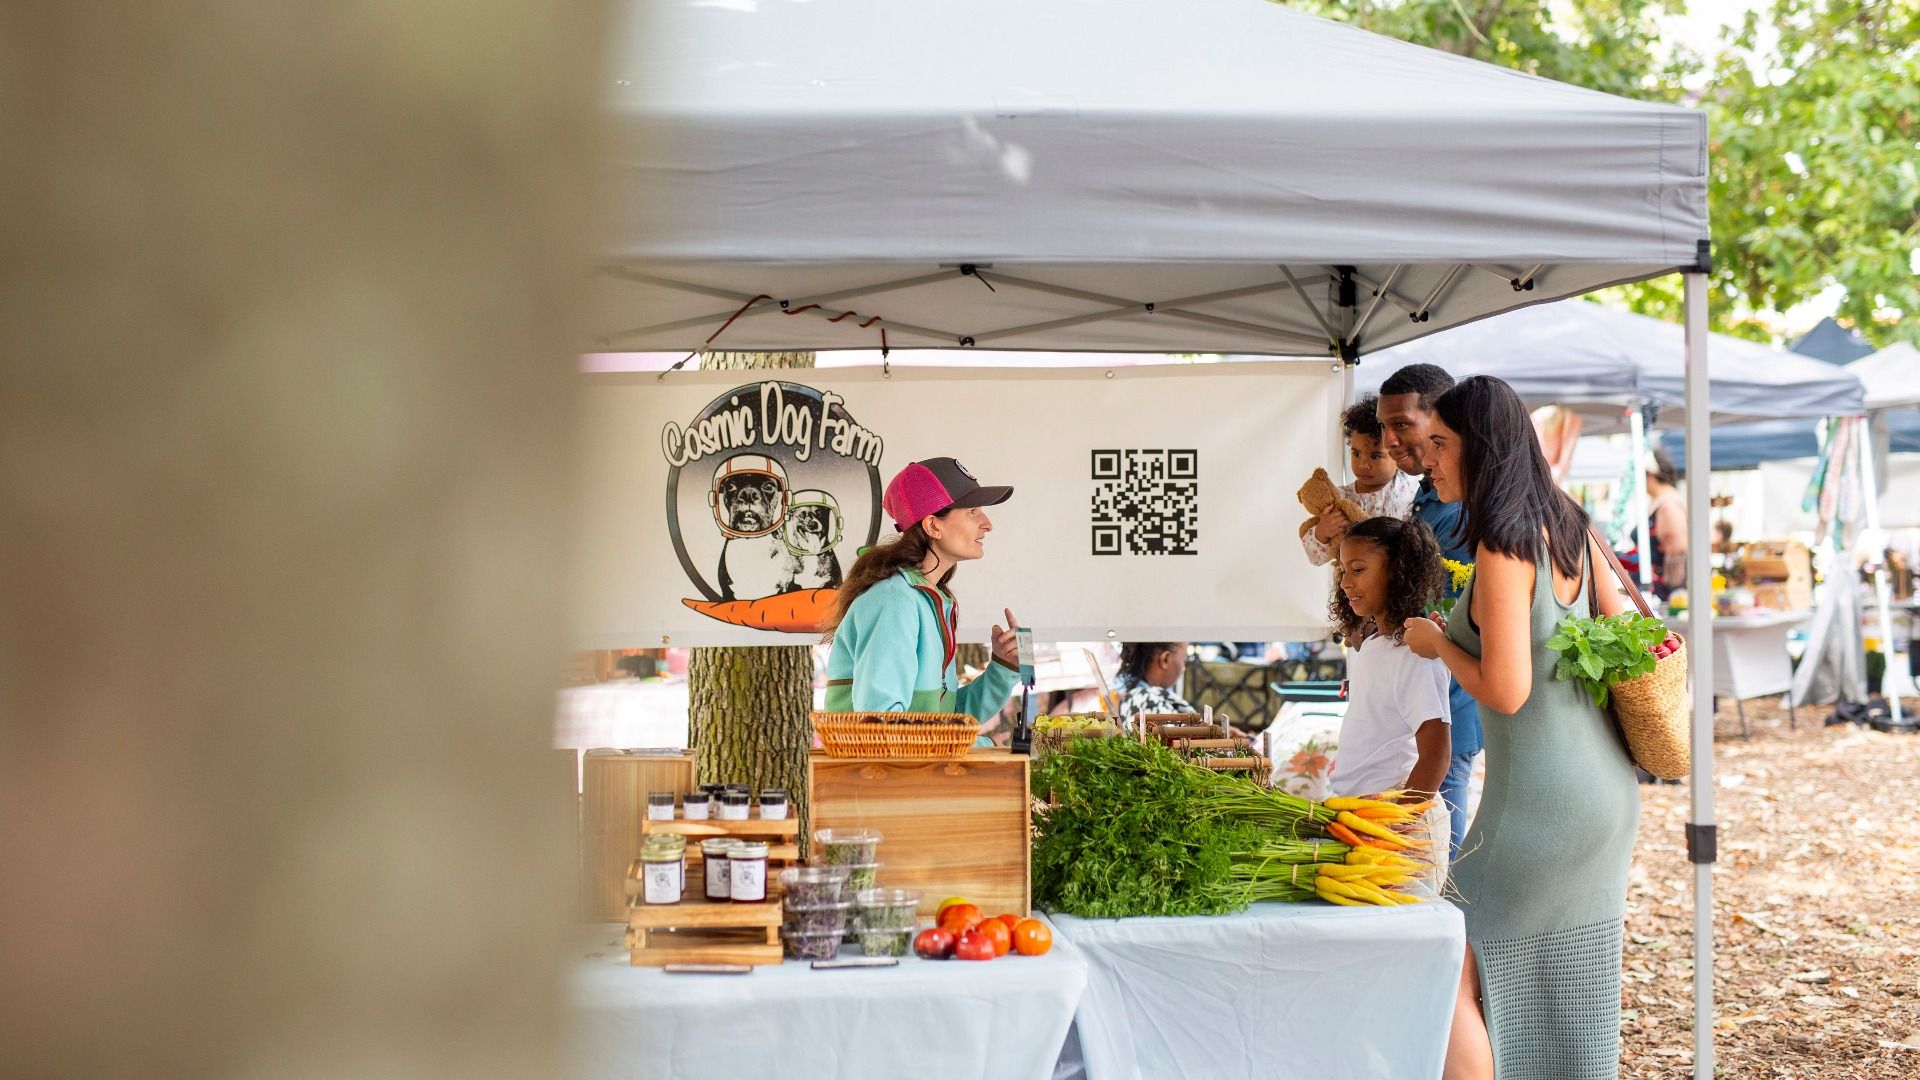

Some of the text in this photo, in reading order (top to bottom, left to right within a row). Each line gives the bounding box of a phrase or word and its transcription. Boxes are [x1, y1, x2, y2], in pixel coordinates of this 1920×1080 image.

[662, 380, 883, 467] Cosmic Dog Farm
